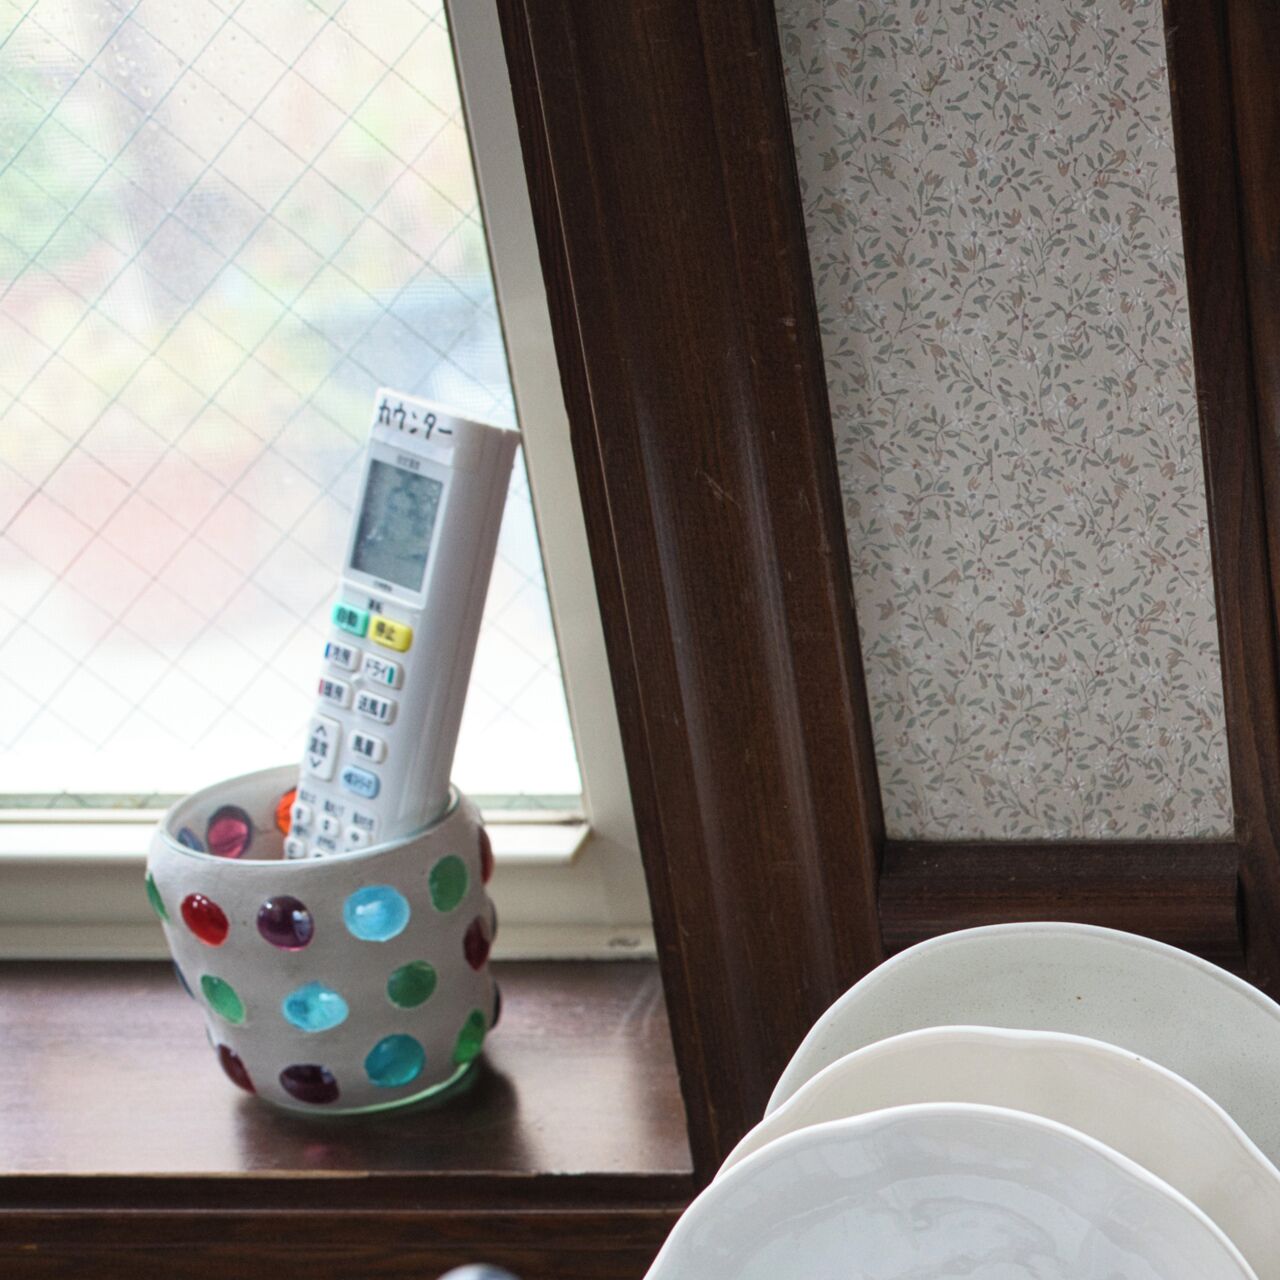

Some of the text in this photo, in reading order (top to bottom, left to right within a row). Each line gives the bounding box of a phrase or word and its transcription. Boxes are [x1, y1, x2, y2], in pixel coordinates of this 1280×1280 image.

[378, 399, 453, 440] カウンター
